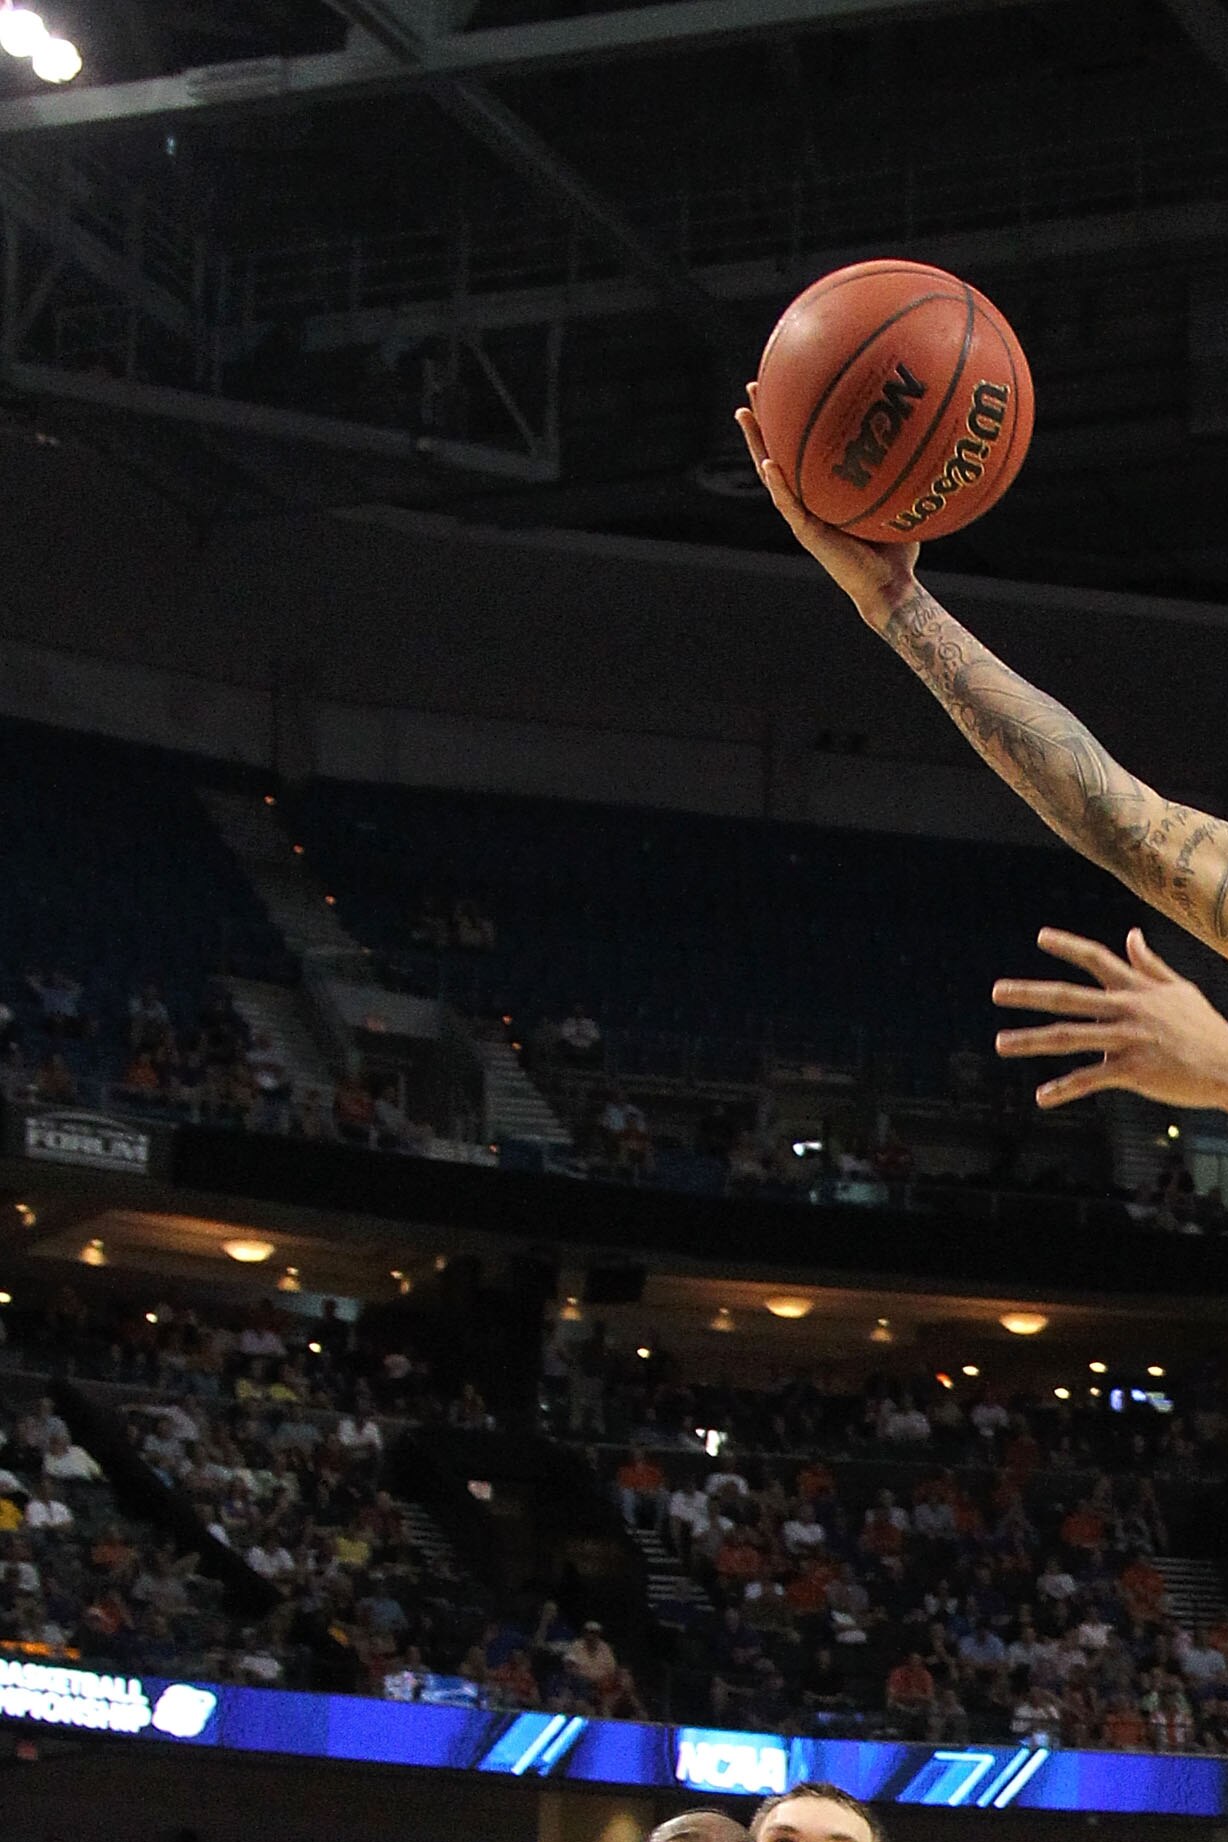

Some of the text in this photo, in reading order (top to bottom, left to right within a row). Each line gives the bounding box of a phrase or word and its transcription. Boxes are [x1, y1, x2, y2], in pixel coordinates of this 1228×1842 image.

[831, 363, 926, 489] NCAA
[882, 379, 1011, 532] Wilson
[675, 1741, 787, 1794] NCAA
